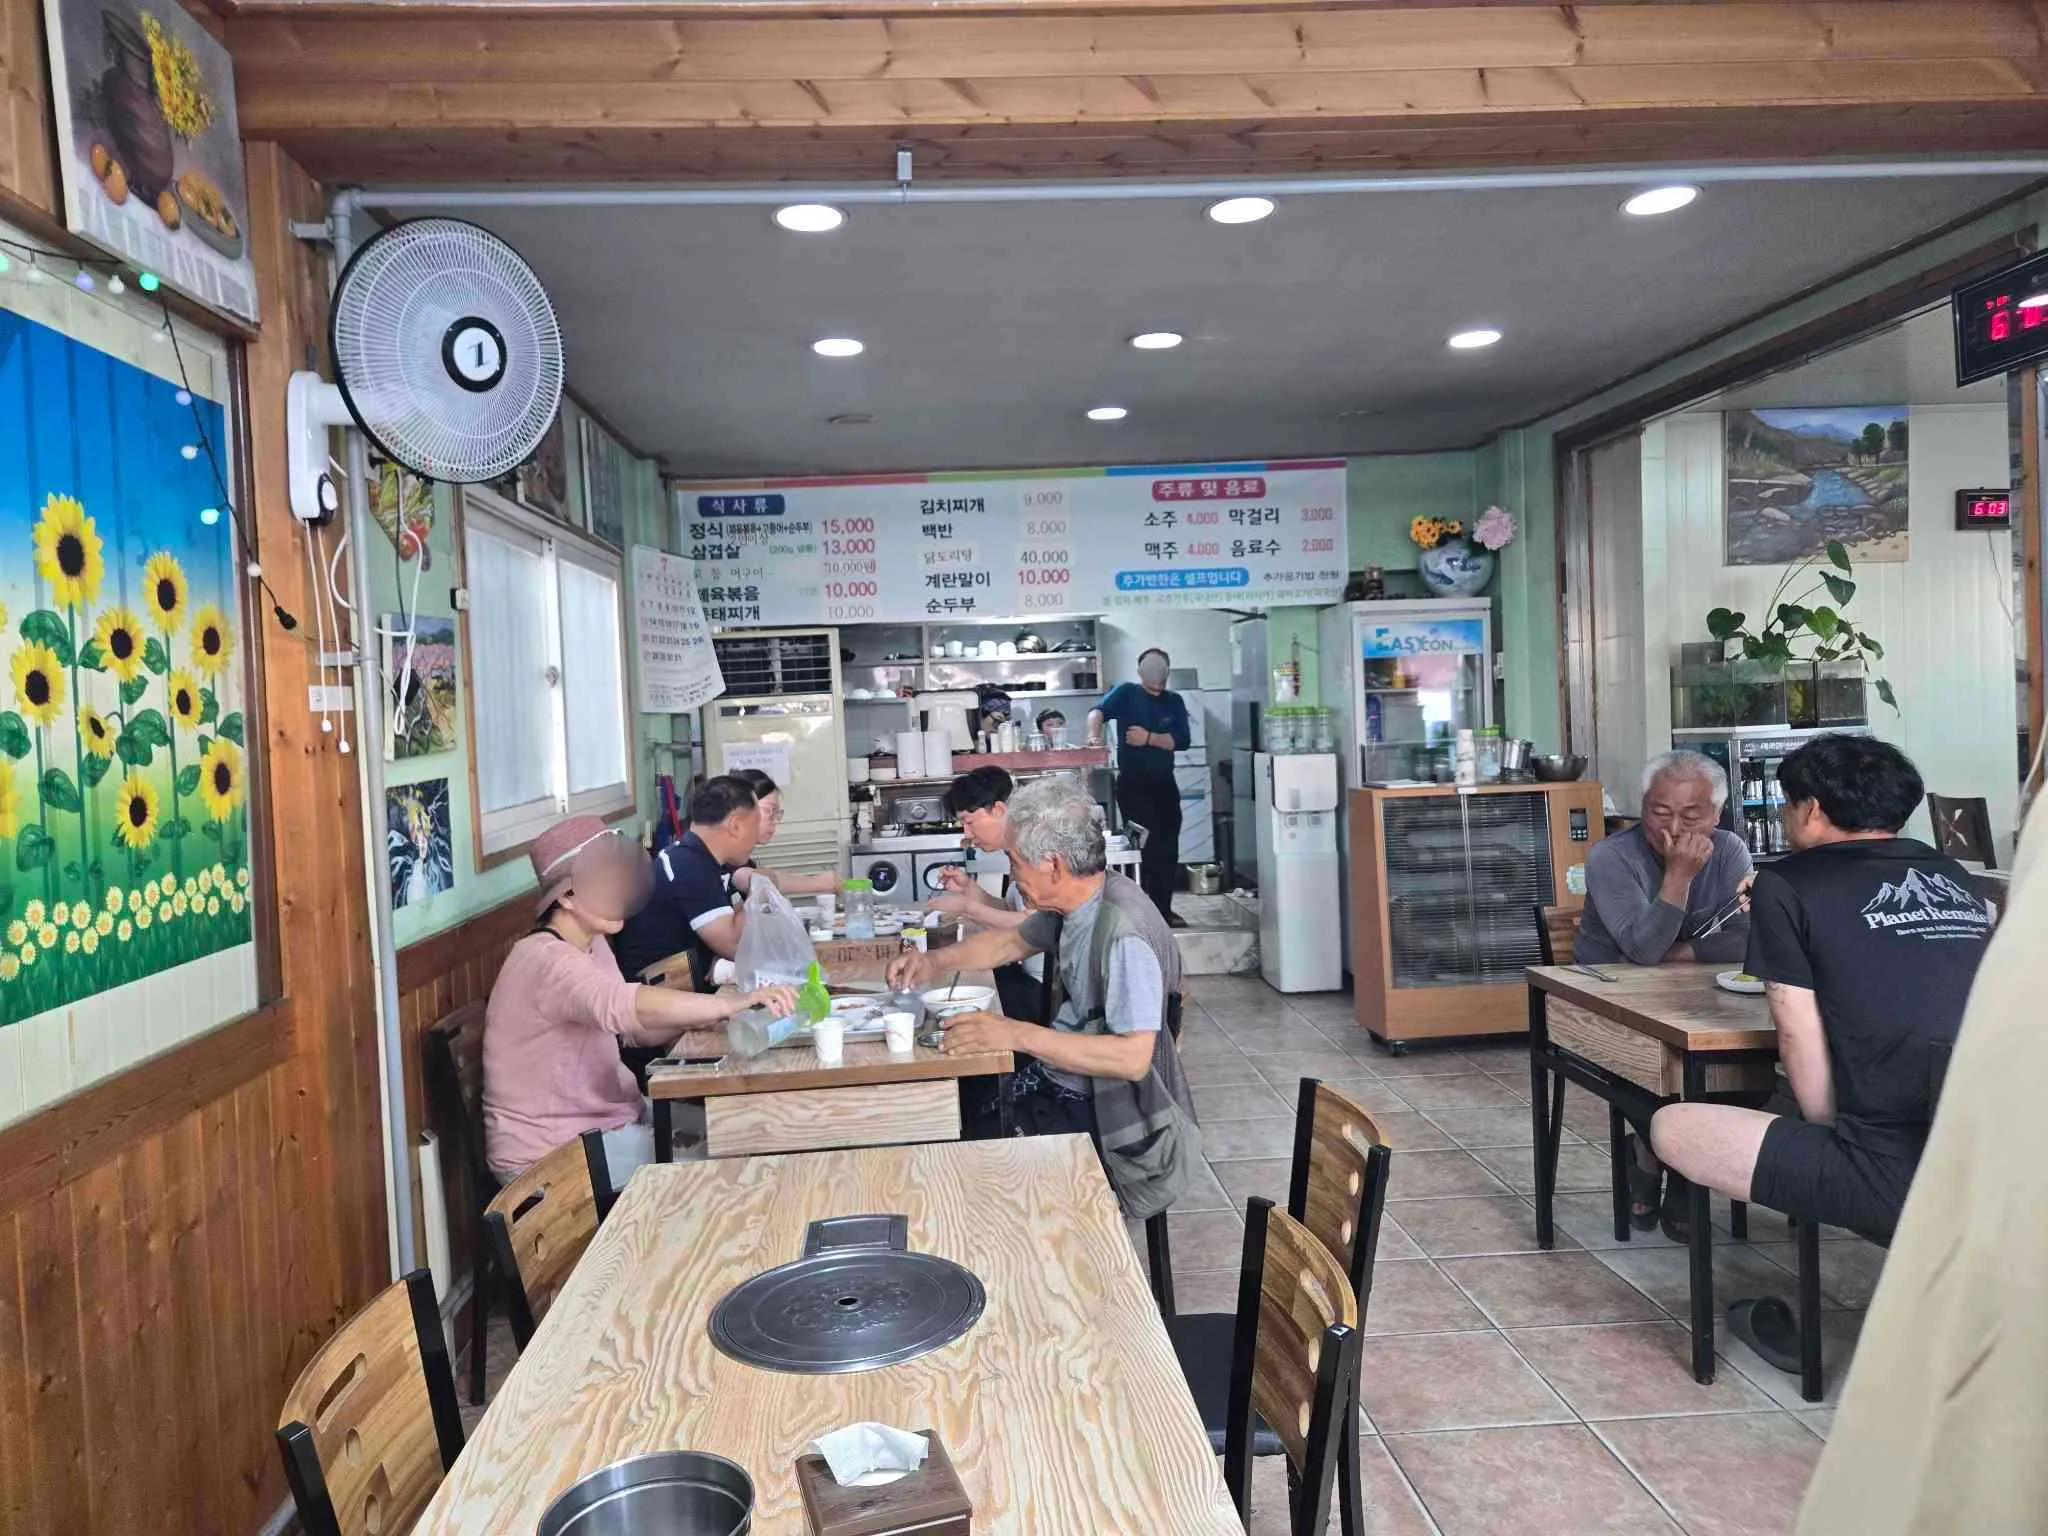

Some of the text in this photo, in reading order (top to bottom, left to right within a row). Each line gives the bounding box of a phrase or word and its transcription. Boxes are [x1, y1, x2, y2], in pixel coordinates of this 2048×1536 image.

[1159, 479, 1259, 497] 주류 및 음료
[920, 497, 985, 514] 김치찌개
[1144, 511, 1177, 528] 소주
[1228, 507, 1280, 526] 막걸리
[689, 522, 723, 540] 정식
[922, 523, 953, 539] 백반
[692, 543, 741, 560] 삼겹살
[1144, 542, 1178, 560] 맥주
[1230, 539, 1282, 557] 음료수
[925, 571, 990, 588] 계란말이
[926, 597, 976, 613] 순두부
[1864, 908, 1930, 929] Planet
